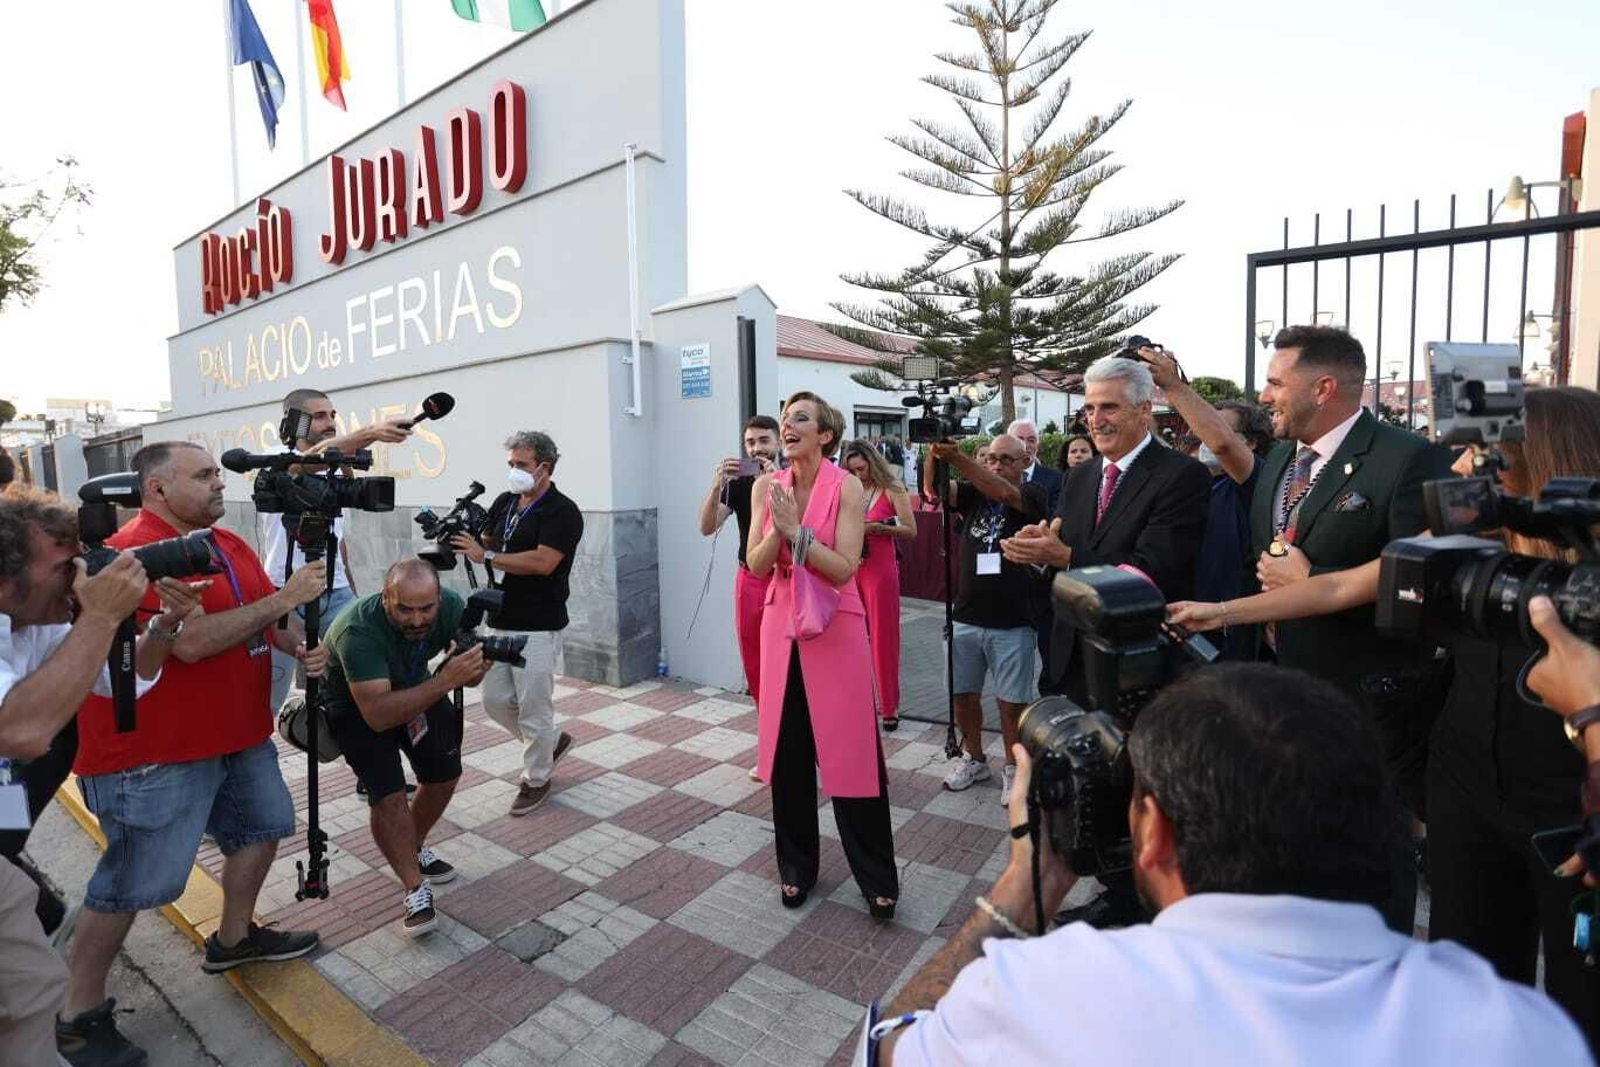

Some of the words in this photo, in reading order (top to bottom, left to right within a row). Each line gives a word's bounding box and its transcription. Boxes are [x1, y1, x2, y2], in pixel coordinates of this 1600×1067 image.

[318, 79, 528, 266] JURADO
[198, 315, 312, 396] PALACIO
[317, 330, 342, 370] de
[345, 246, 524, 364] FERIAS
